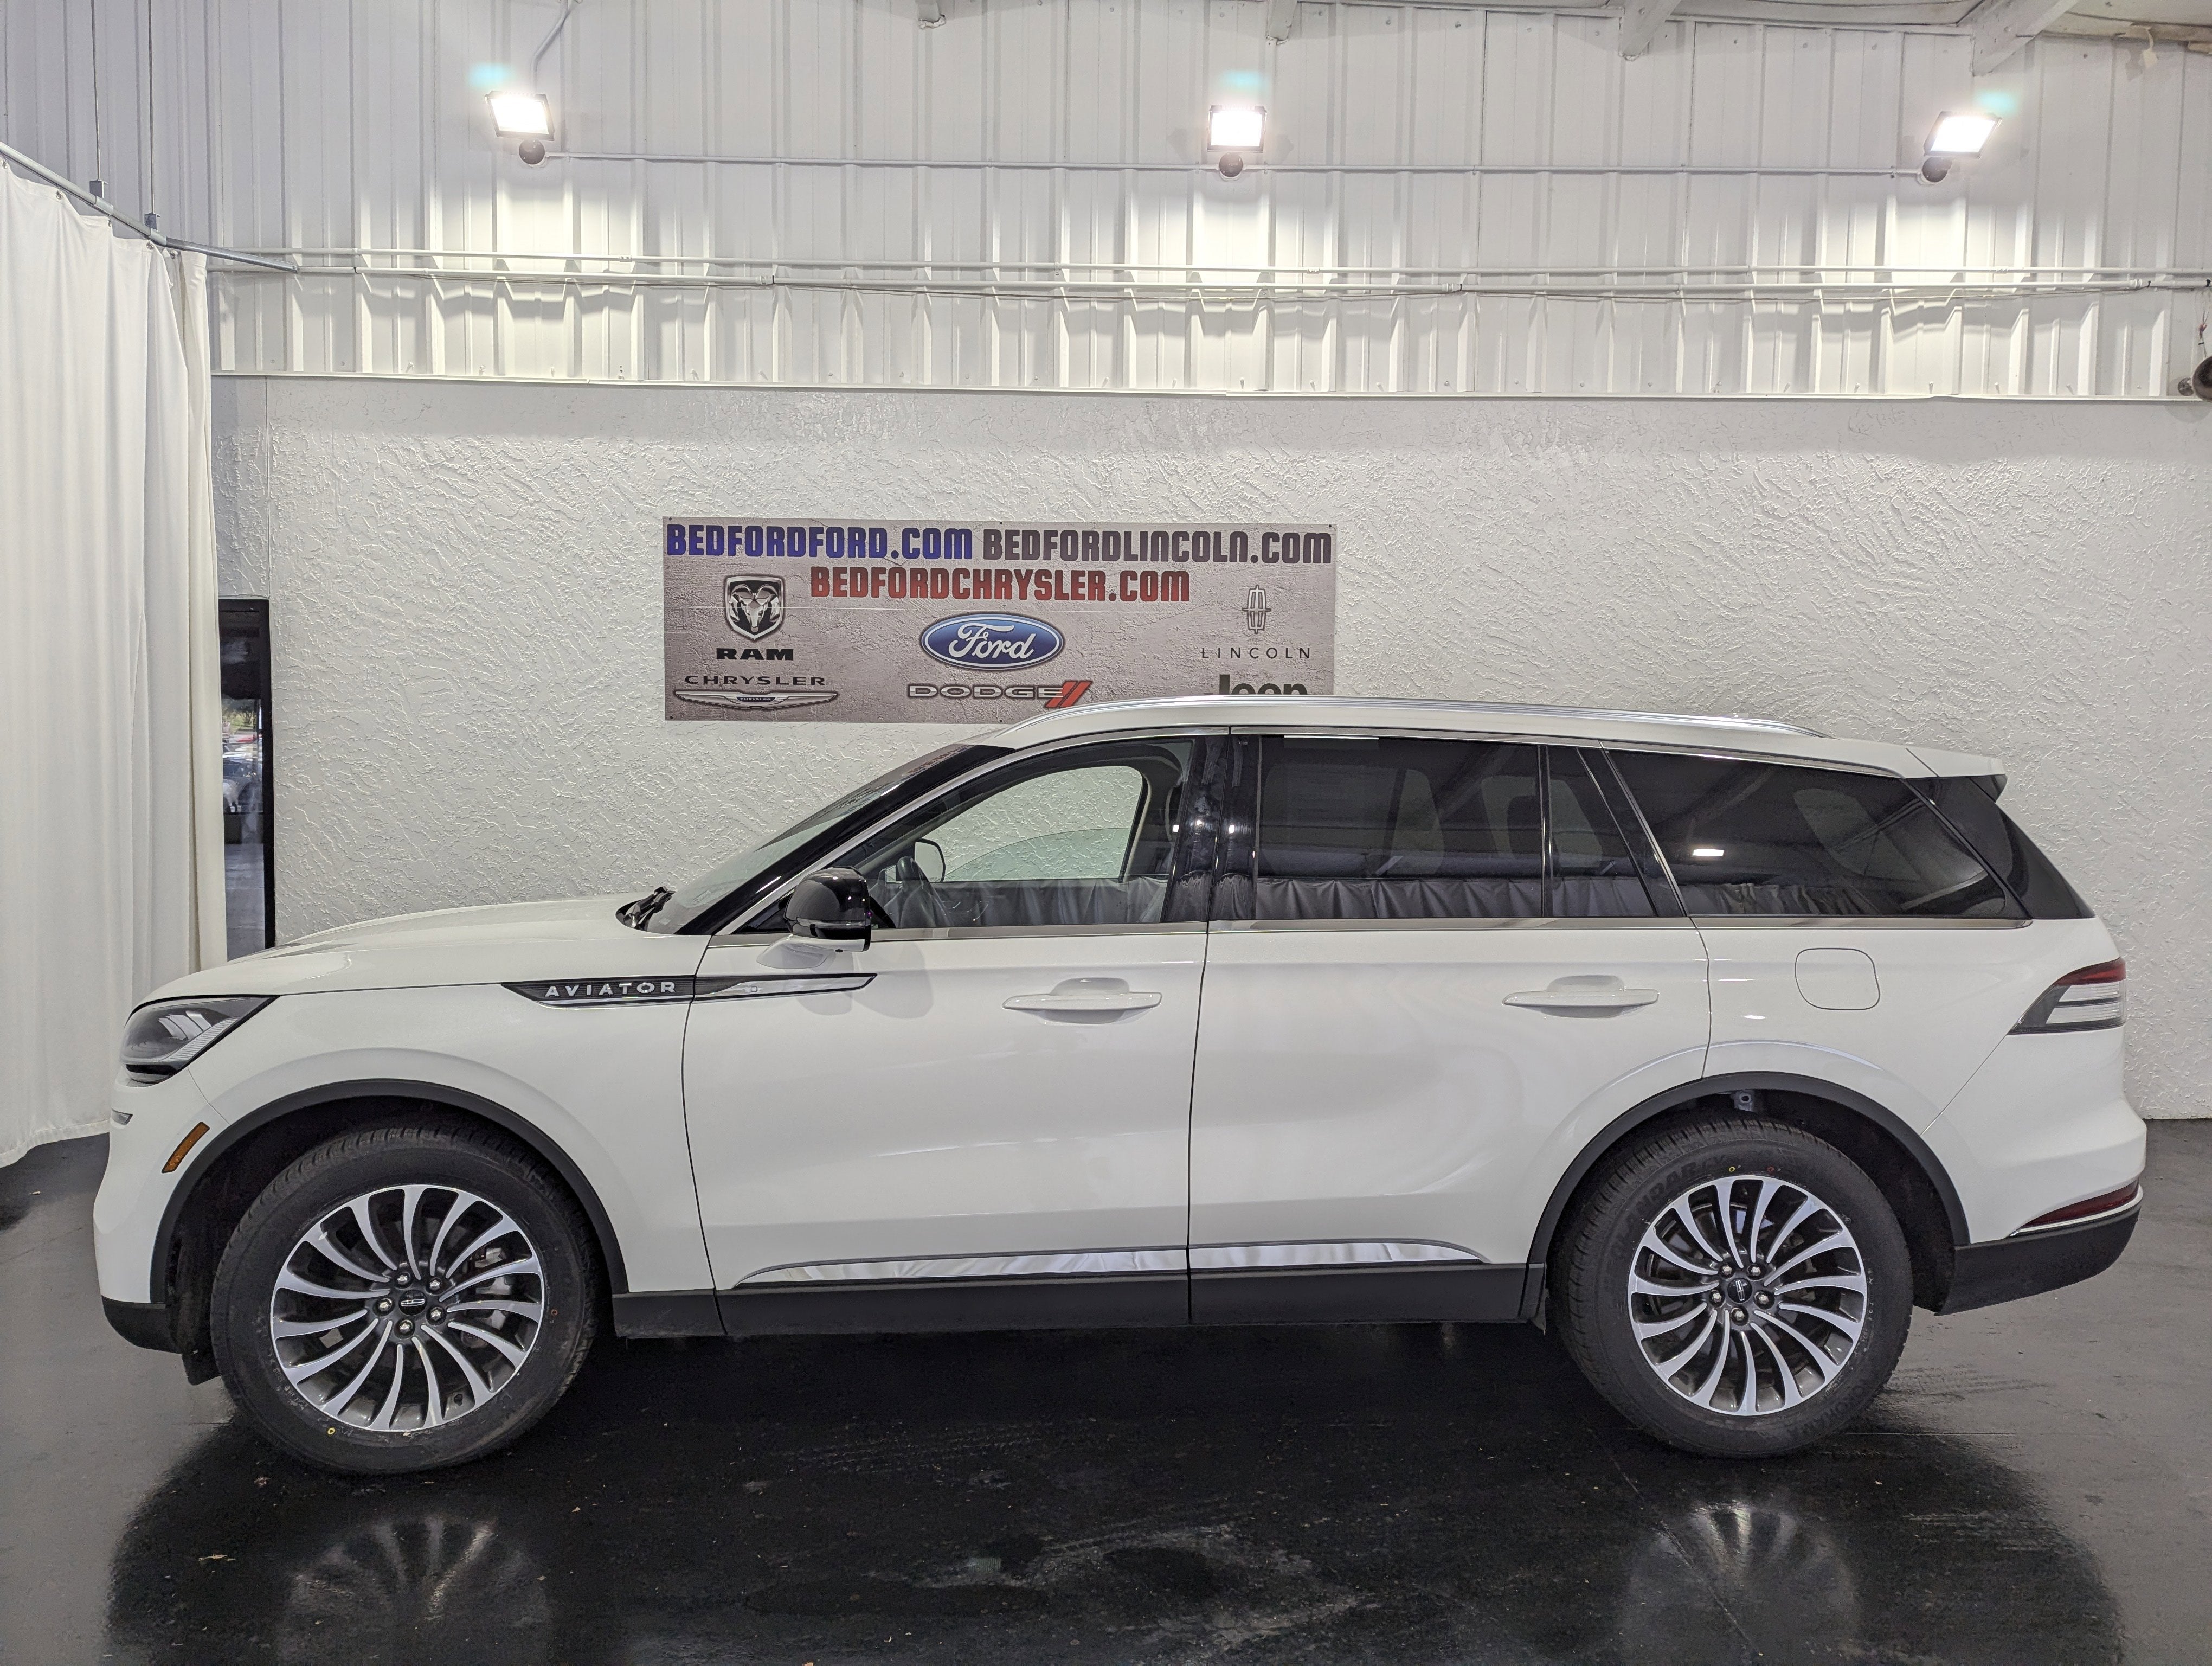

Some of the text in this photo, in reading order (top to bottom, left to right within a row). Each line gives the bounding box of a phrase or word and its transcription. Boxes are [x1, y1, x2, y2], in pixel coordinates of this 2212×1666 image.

[667, 524, 1332, 563] BEDFORDFORD.COM BEDFORDLINCOLN.COM
[811, 566, 1189, 602] BEDFORDCHRYSLER.COM
[949, 623, 1037, 659] Ford
[716, 648, 794, 661] RAM
[1201, 647, 1310, 659] LINCOLN
[685, 675, 825, 686] CHRYSLER
[909, 685, 1064, 698] DODGE
[545, 982, 676, 997] AVIATOR
